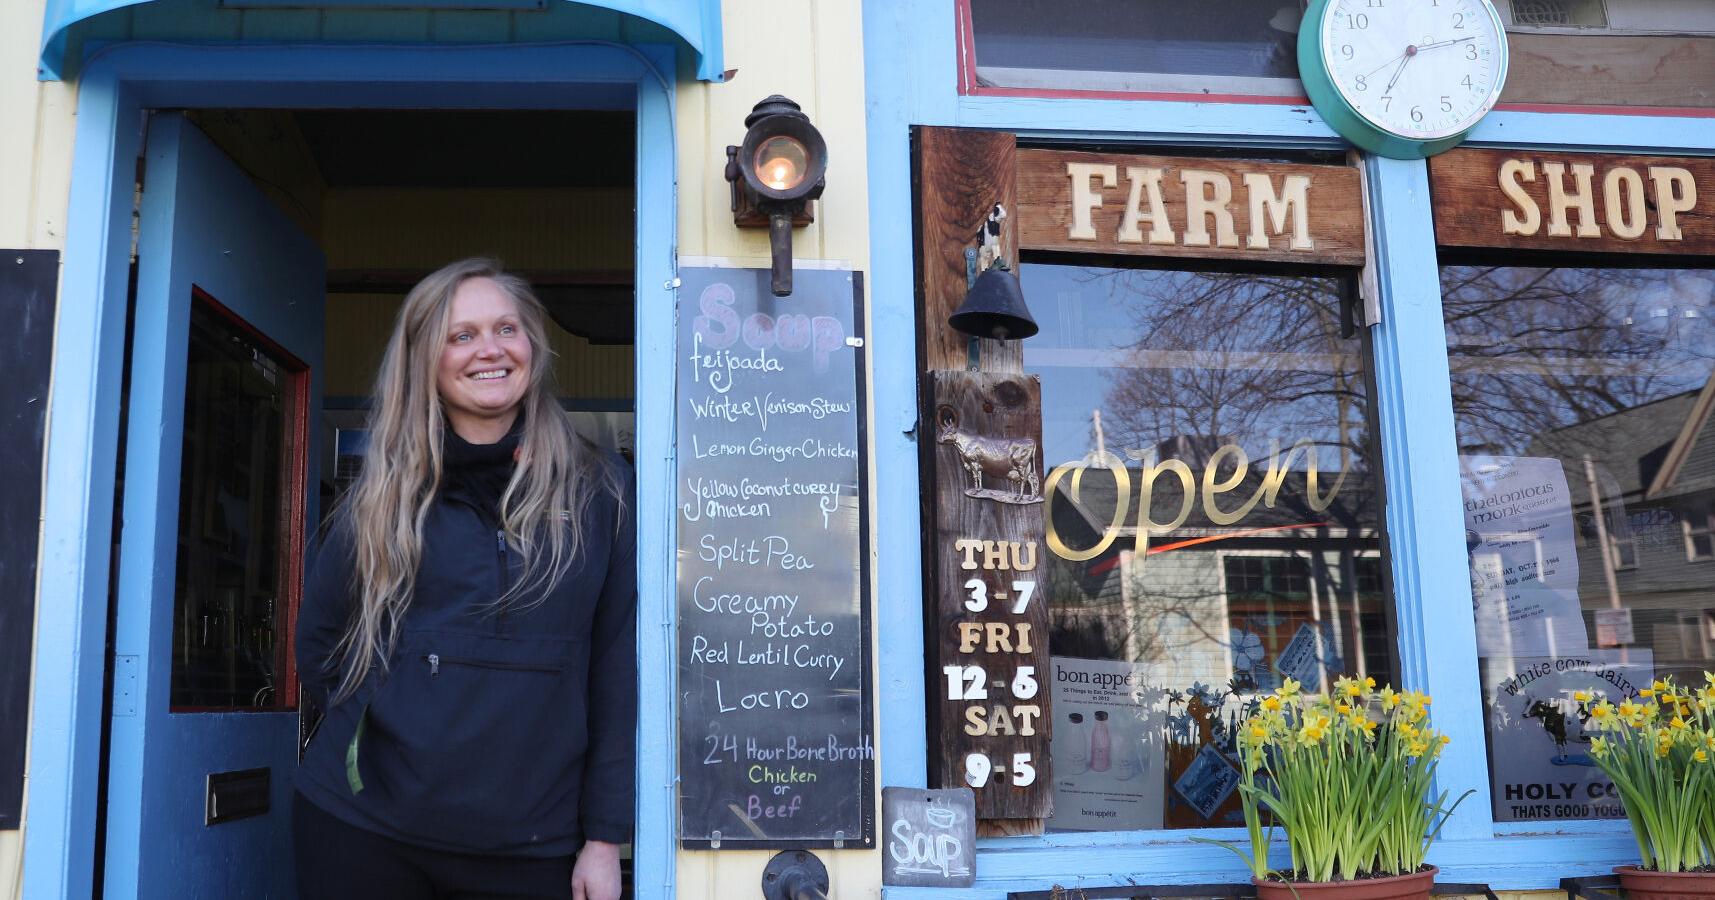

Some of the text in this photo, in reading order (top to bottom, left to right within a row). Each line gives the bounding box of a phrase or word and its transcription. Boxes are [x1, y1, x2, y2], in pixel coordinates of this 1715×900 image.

[1347, 13, 1368, 30] 10
[1452, 12, 1465, 30] 2
[1341, 44, 1354, 61] 9
[1465, 43, 1478, 61] 3
[1355, 74, 1368, 92] 8
[1460, 74, 1473, 91] 4
[1380, 96, 1393, 113] 7
[1410, 105, 1423, 123] 6
[1440, 96, 1452, 112] 5
[1066, 162, 1314, 250] FARM
[1498, 159, 1697, 241] SHOP
[693, 283, 845, 374] Soup
[754, 391, 812, 432] Venison
[811, 398, 850, 419] Stew
[693, 434, 857, 462] Lemon Ginger Chicken
[683, 477, 738, 521] Yellow
[741, 477, 792, 500] Coconut
[1044, 438, 1350, 578] Open
[699, 534, 814, 571] Split Pea
[955, 539, 1037, 571] THU
[750, 611, 834, 638] Potato
[957, 622, 1033, 653] FRI
[690, 635, 844, 681] Red Lentil Curry
[1057, 665, 1090, 684] bon
[1504, 662, 1551, 697] white
[1595, 662, 1641, 699] dairy
[716, 680, 809, 713] Locro
[964, 705, 1040, 736] SAT
[704, 734, 875, 765] 24 Hour Bone Broth
[749, 765, 817, 784] Chicken
[773, 784, 791, 796] or
[1505, 782, 1619, 801] HOLY CO
[747, 794, 801, 820] Beef
[1081, 808, 1095, 816] bon
[1511, 802, 1627, 818] THATS GOOD YOGU
[889, 819, 962, 878] Soup
